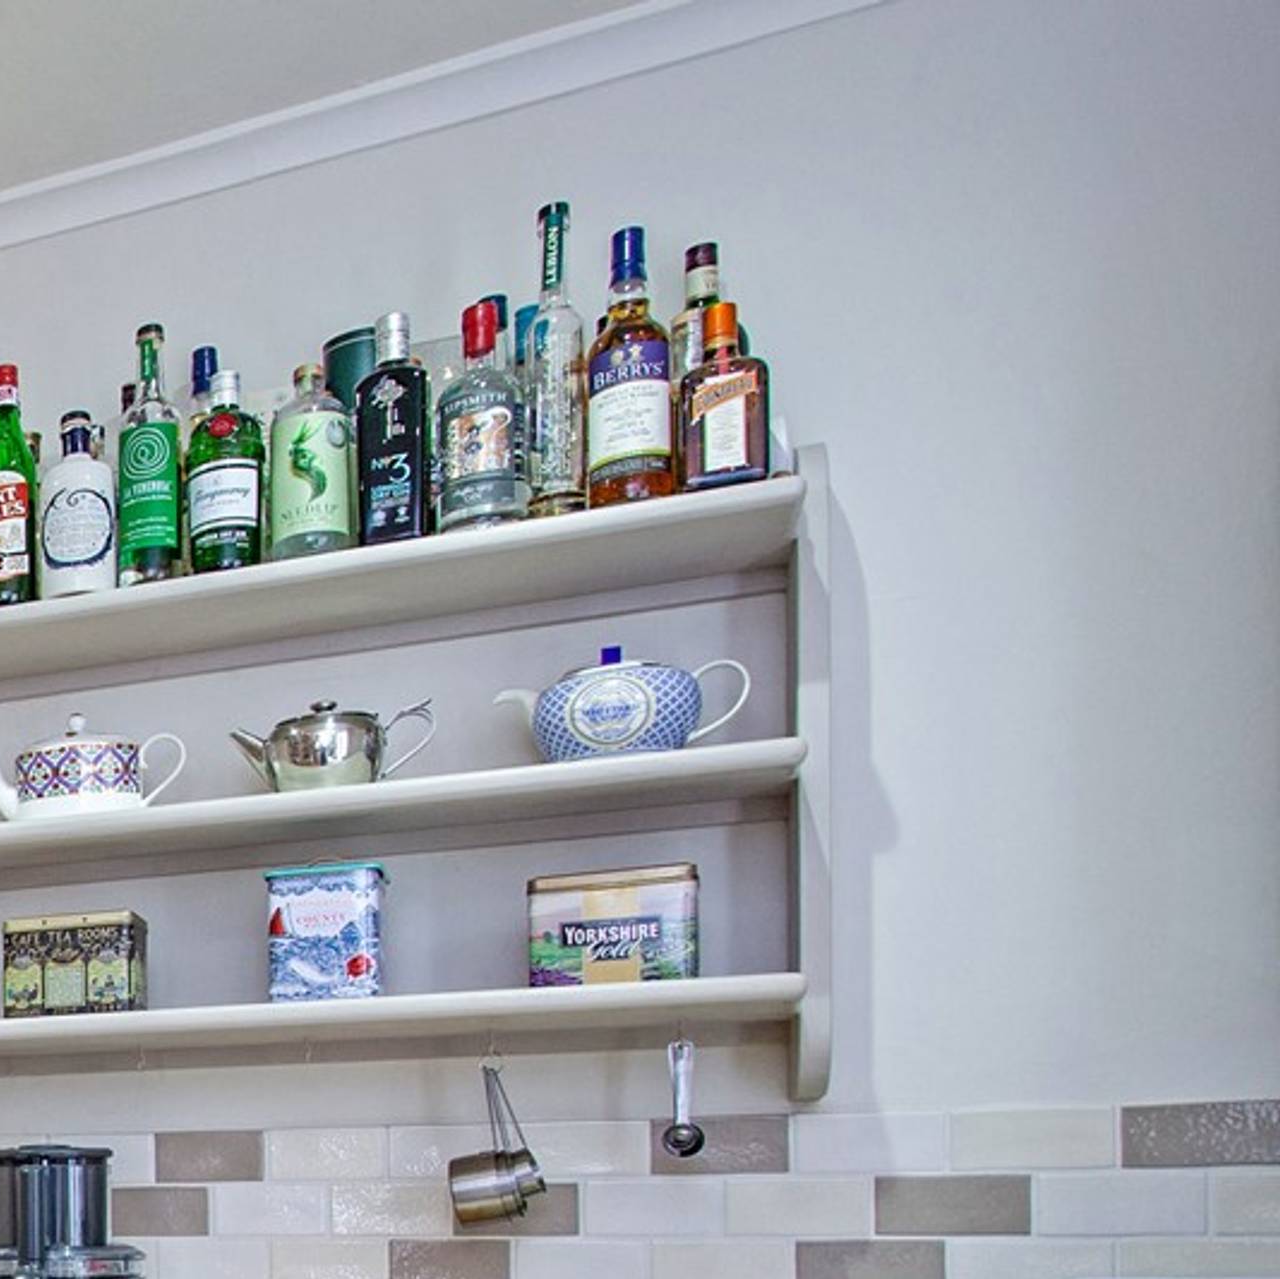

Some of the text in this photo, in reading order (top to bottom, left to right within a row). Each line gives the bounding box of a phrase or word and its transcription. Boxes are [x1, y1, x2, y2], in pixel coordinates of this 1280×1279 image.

[388, 452, 411, 482] 3
[47, 931, 72, 944] TEA
[77, 926, 119, 943] ROOMS
[564, 922, 661, 945] YORKSHIRE
[587, 938, 641, 962] Gold
